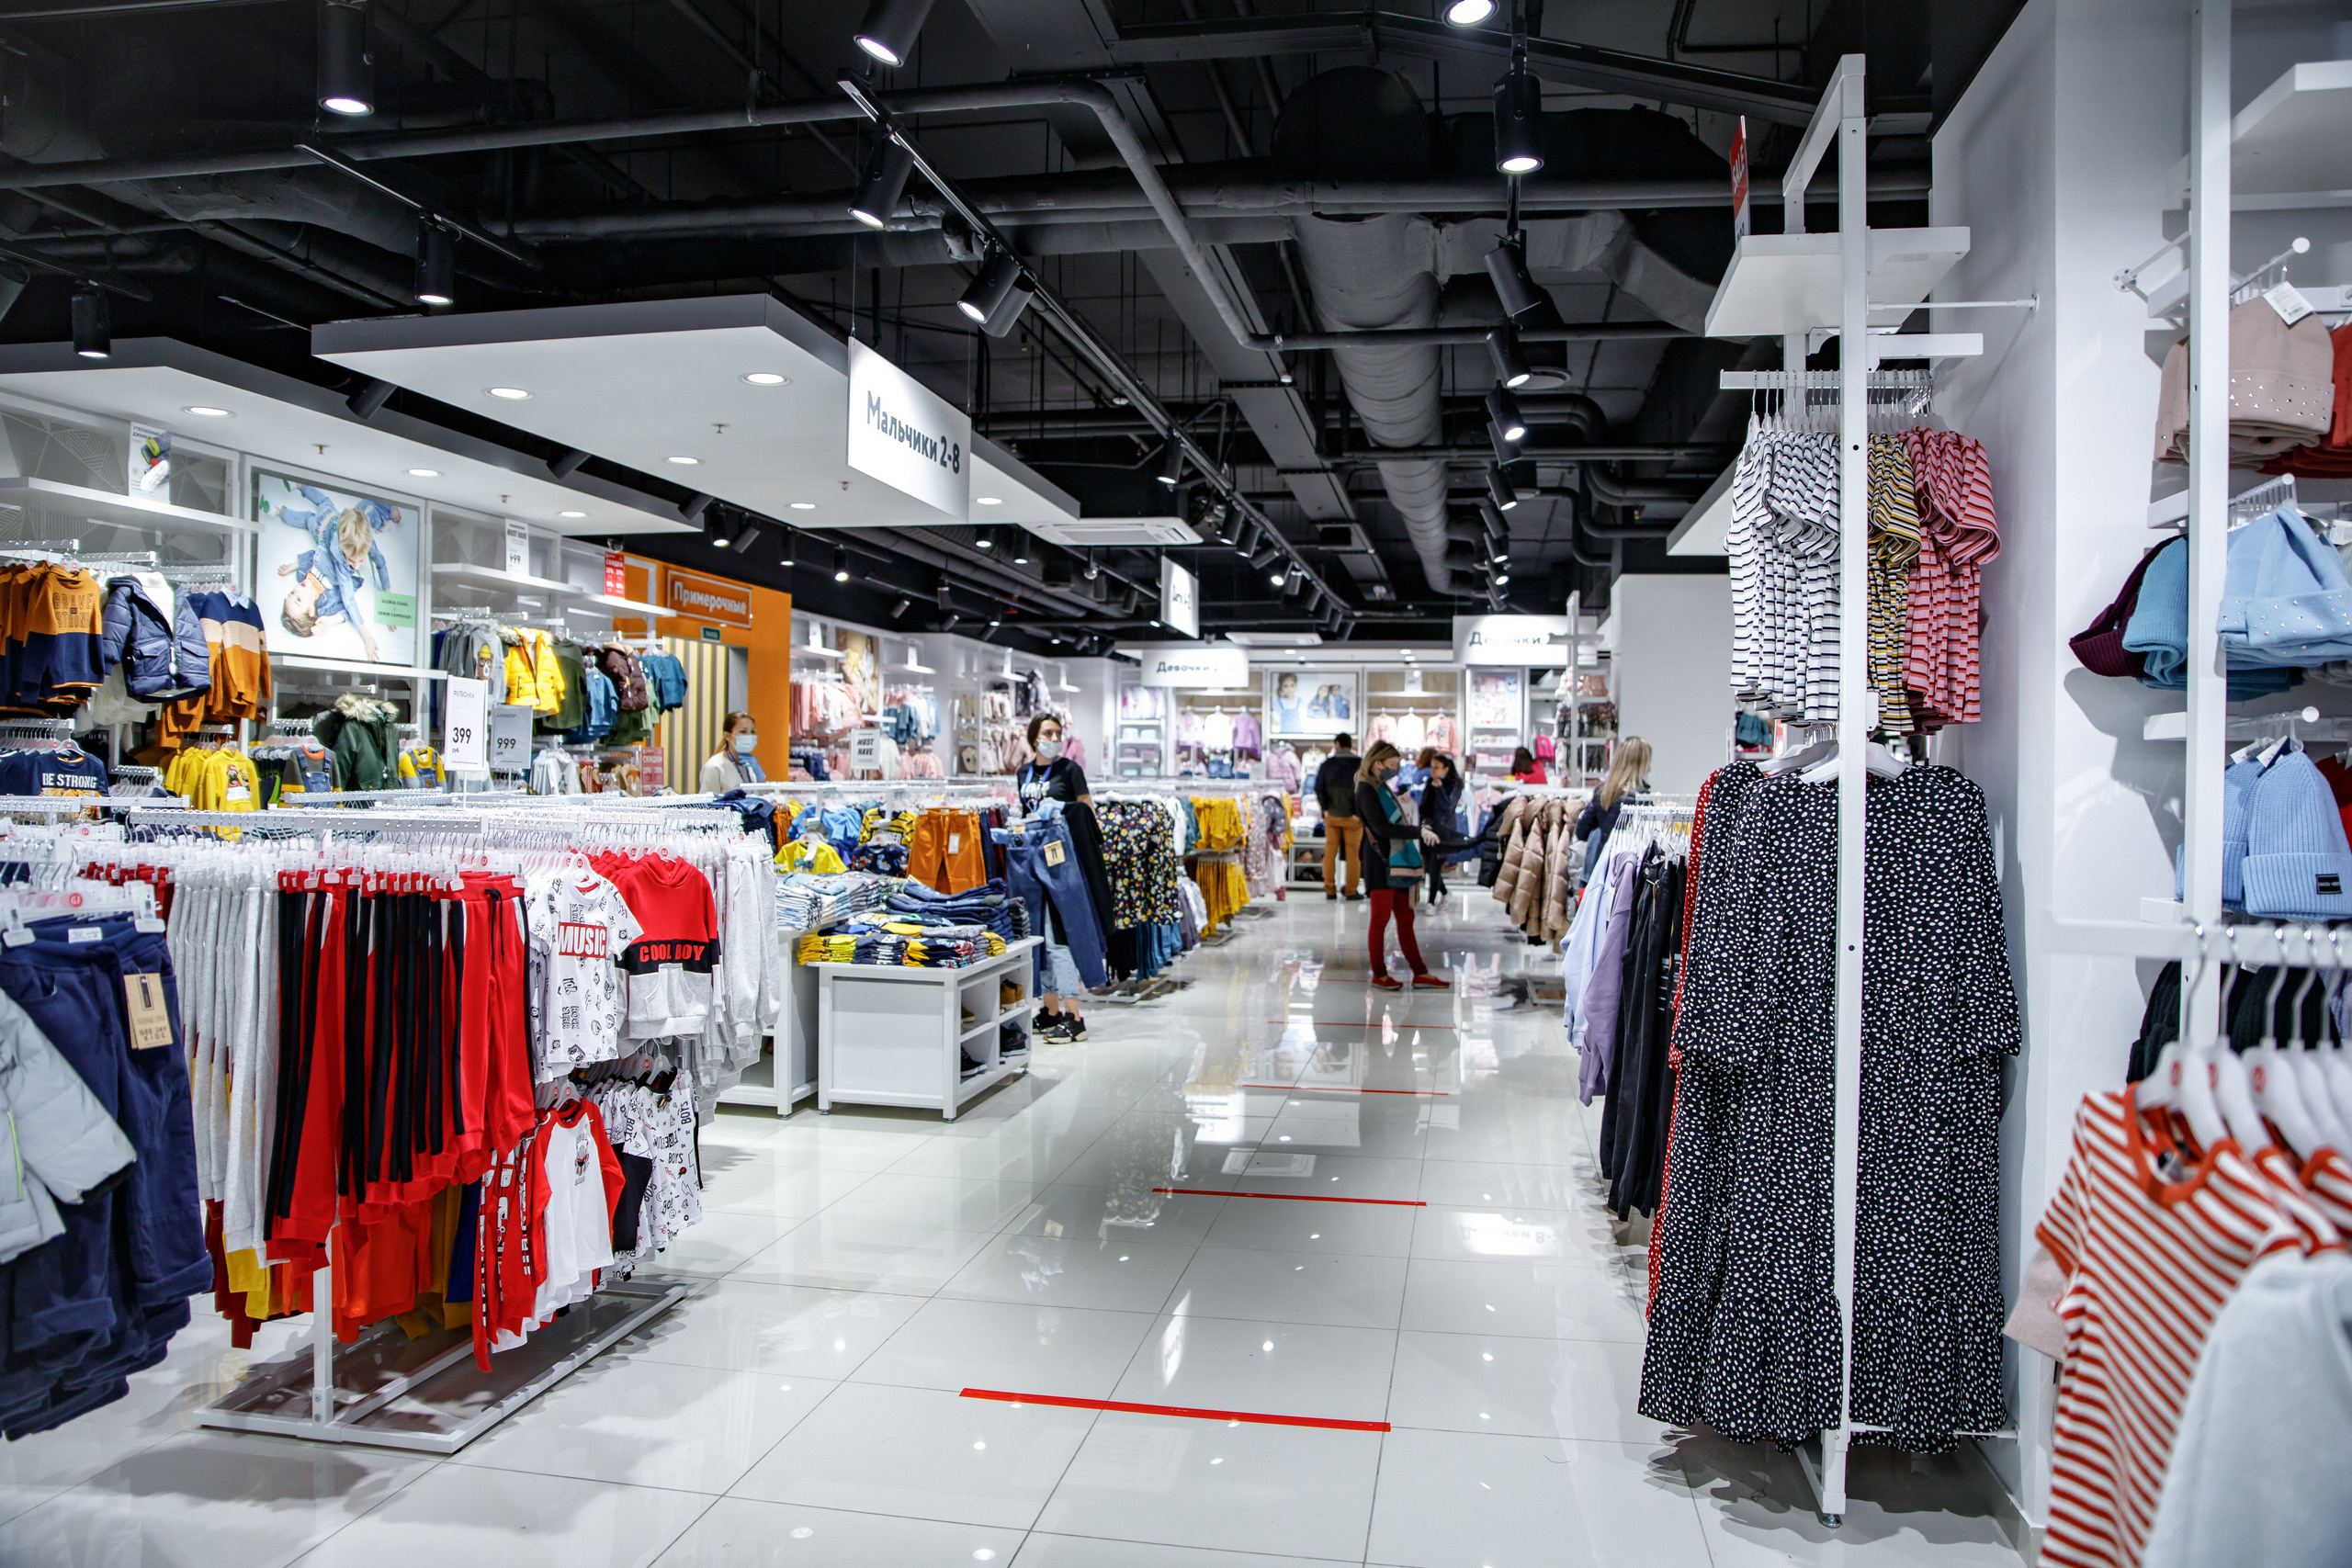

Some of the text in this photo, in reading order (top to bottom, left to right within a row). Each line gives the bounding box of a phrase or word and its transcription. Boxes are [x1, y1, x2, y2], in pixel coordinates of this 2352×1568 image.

[1732, 142, 1746, 195] SALE
[866, 389, 960, 475] Мальчики 2-8
[52, 592, 94, 609] BRAVE
[673, 580, 747, 615] Примерочные
[1469, 632, 1542, 647] Дечки
[453, 690, 475, 699] ФУТБОЛКА
[452, 727, 471, 744] 399
[497, 738, 516, 750] 999
[856, 738, 875, 746] MUST
[856, 748, 874, 756] HAVE
[41, 773, 98, 789] BE STRONG
[559, 924, 606, 956] MUSIC
[639, 943, 706, 963] COOL BOY
[561, 1006, 571, 1030] STAR
[571, 1006, 580, 1030] ROCK
[681, 1100, 693, 1125] BOYS
[625, 1117, 636, 1143] BOYS
[668, 1152, 684, 1164] BOYS
